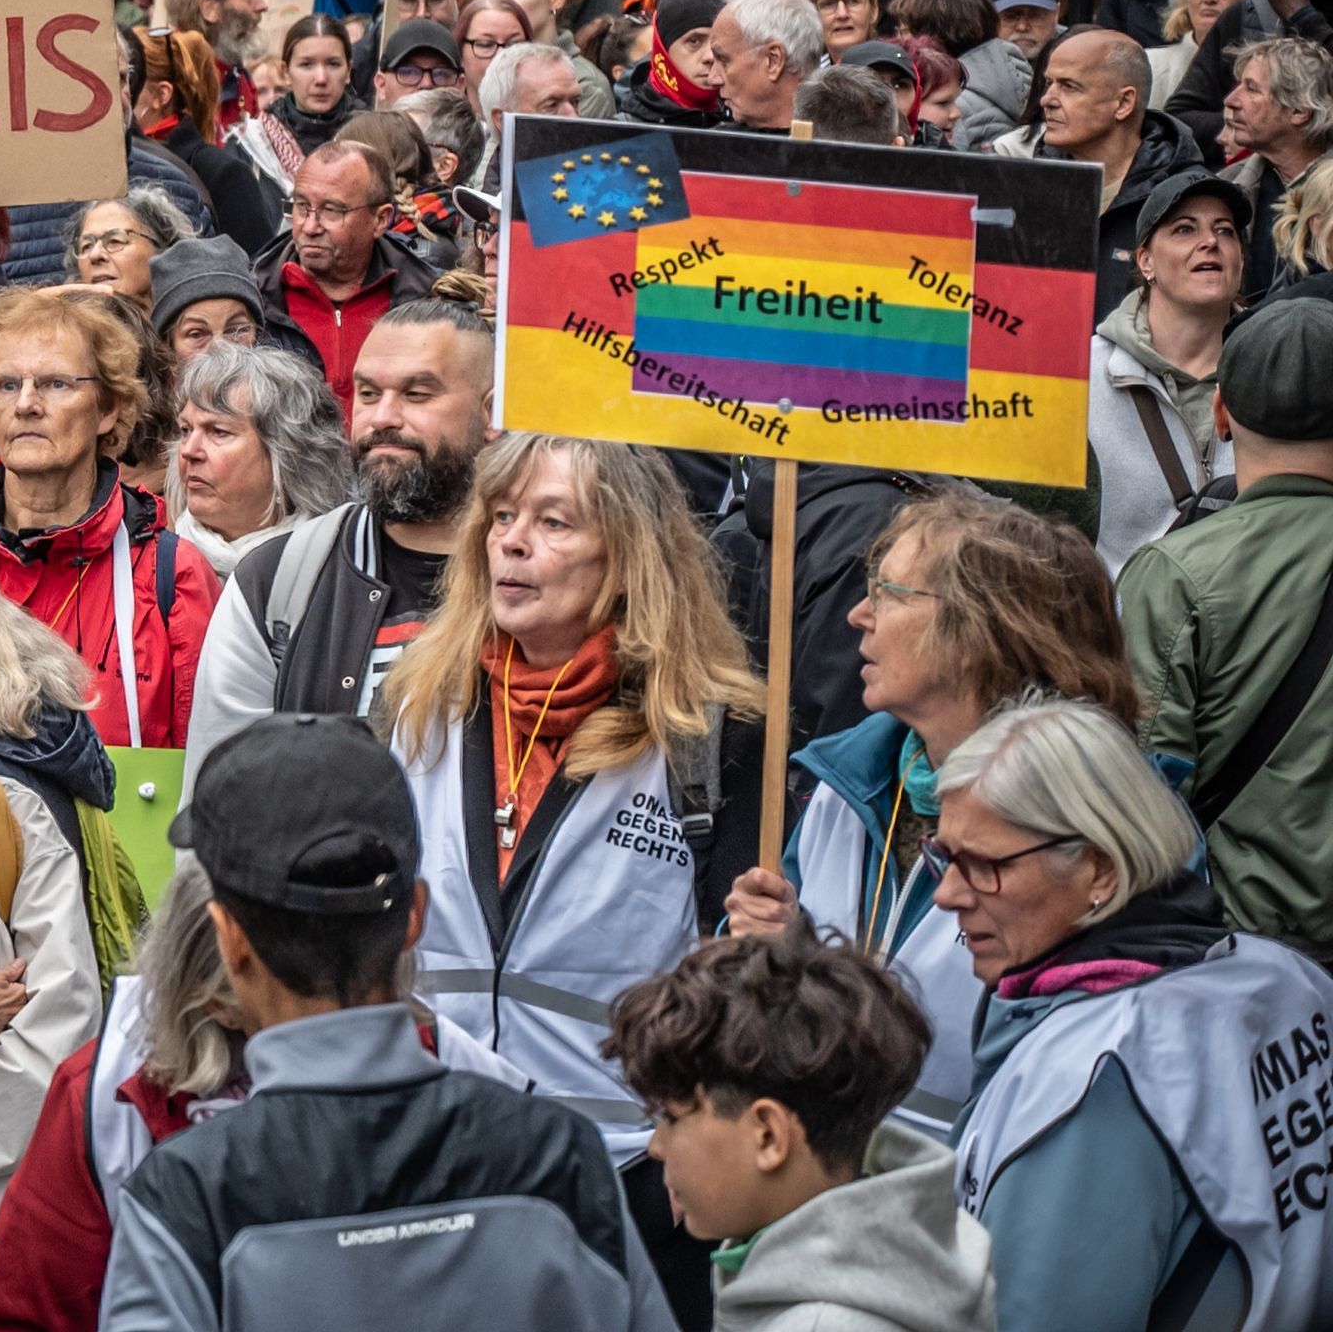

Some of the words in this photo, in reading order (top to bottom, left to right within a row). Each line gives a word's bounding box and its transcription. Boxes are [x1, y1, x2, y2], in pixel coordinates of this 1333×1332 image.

[608, 234, 726, 298] Respekt
[713, 275, 884, 326] Freiheit
[904, 254, 1025, 337] Toleranz
[561, 309, 793, 447] Hilfsbereitschaft
[820, 392, 1035, 426] Gemeinschaft
[605, 827, 690, 867] RECHTS
[616, 809, 684, 844] GEGEN
[1250, 1011, 1331, 1107] MAS
[336, 1225, 397, 1248] UNDER
